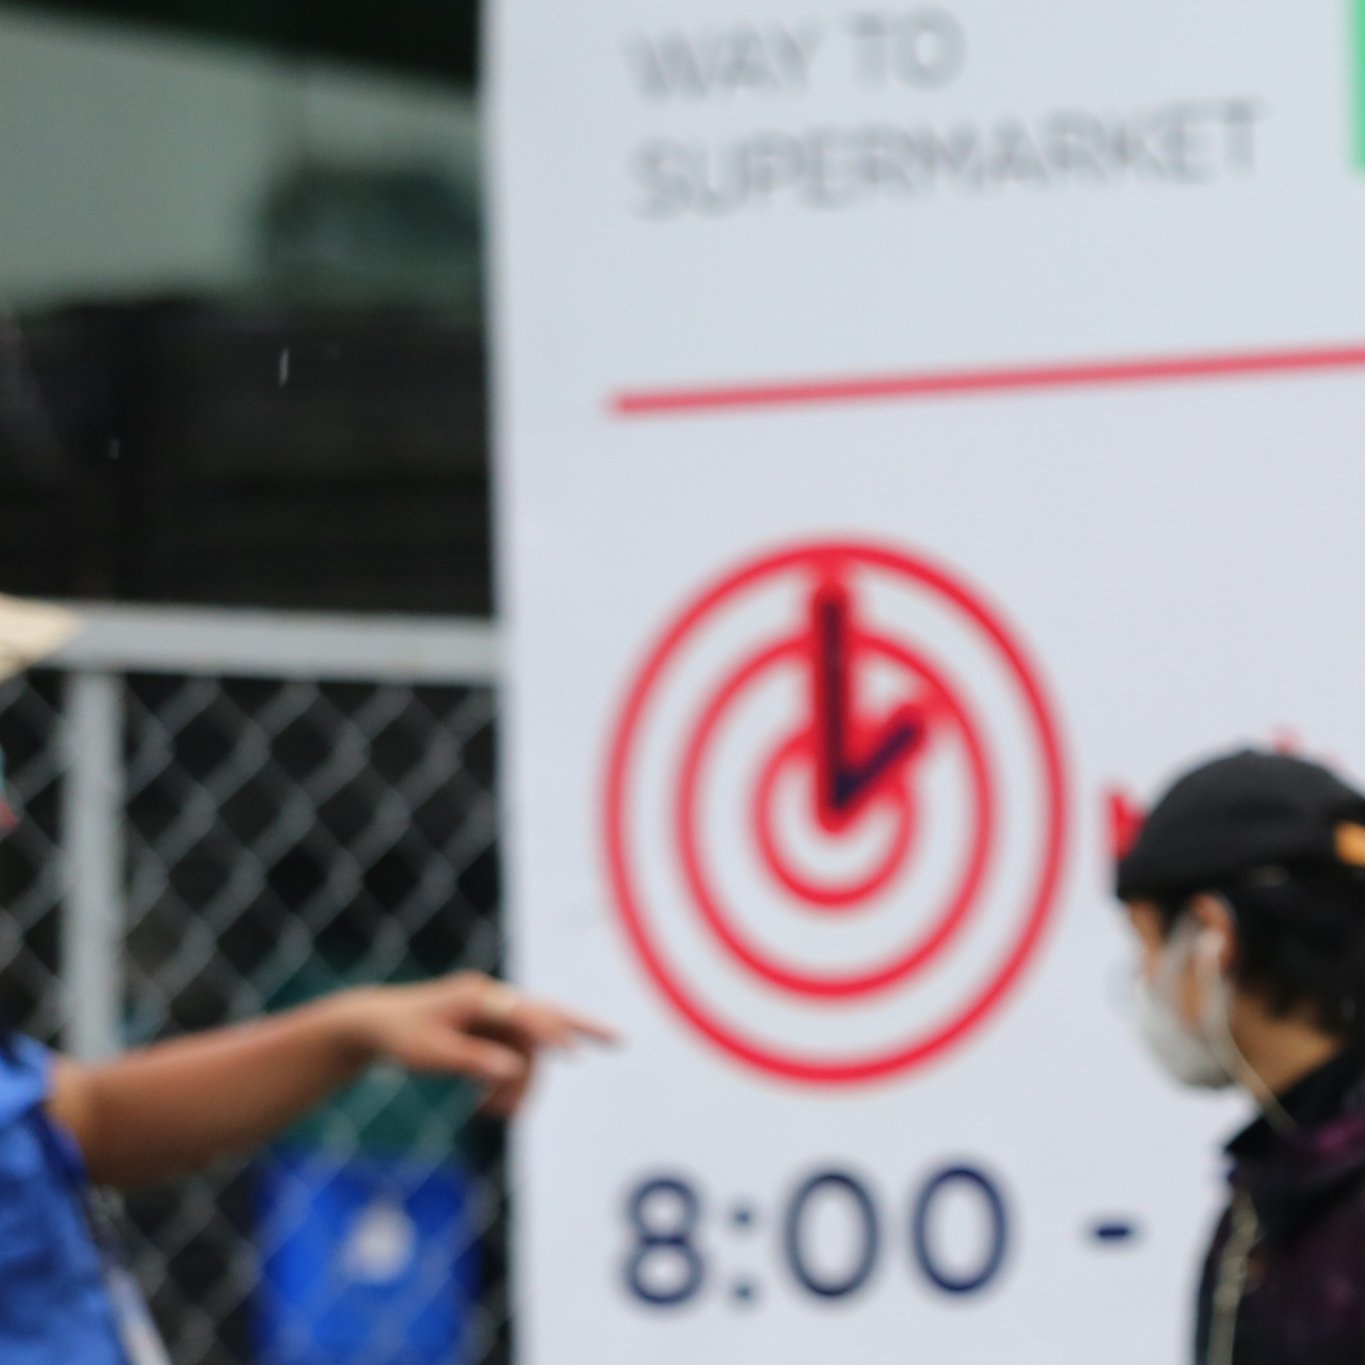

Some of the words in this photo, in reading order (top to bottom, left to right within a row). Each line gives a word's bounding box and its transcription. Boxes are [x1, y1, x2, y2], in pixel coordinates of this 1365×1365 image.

[622, 18, 822, 103] WAY
[846, 6, 966, 89] TO
[629, 97, 1264, 219] SUPERMARKET
[626, 1165, 1010, 1305] 8:00
